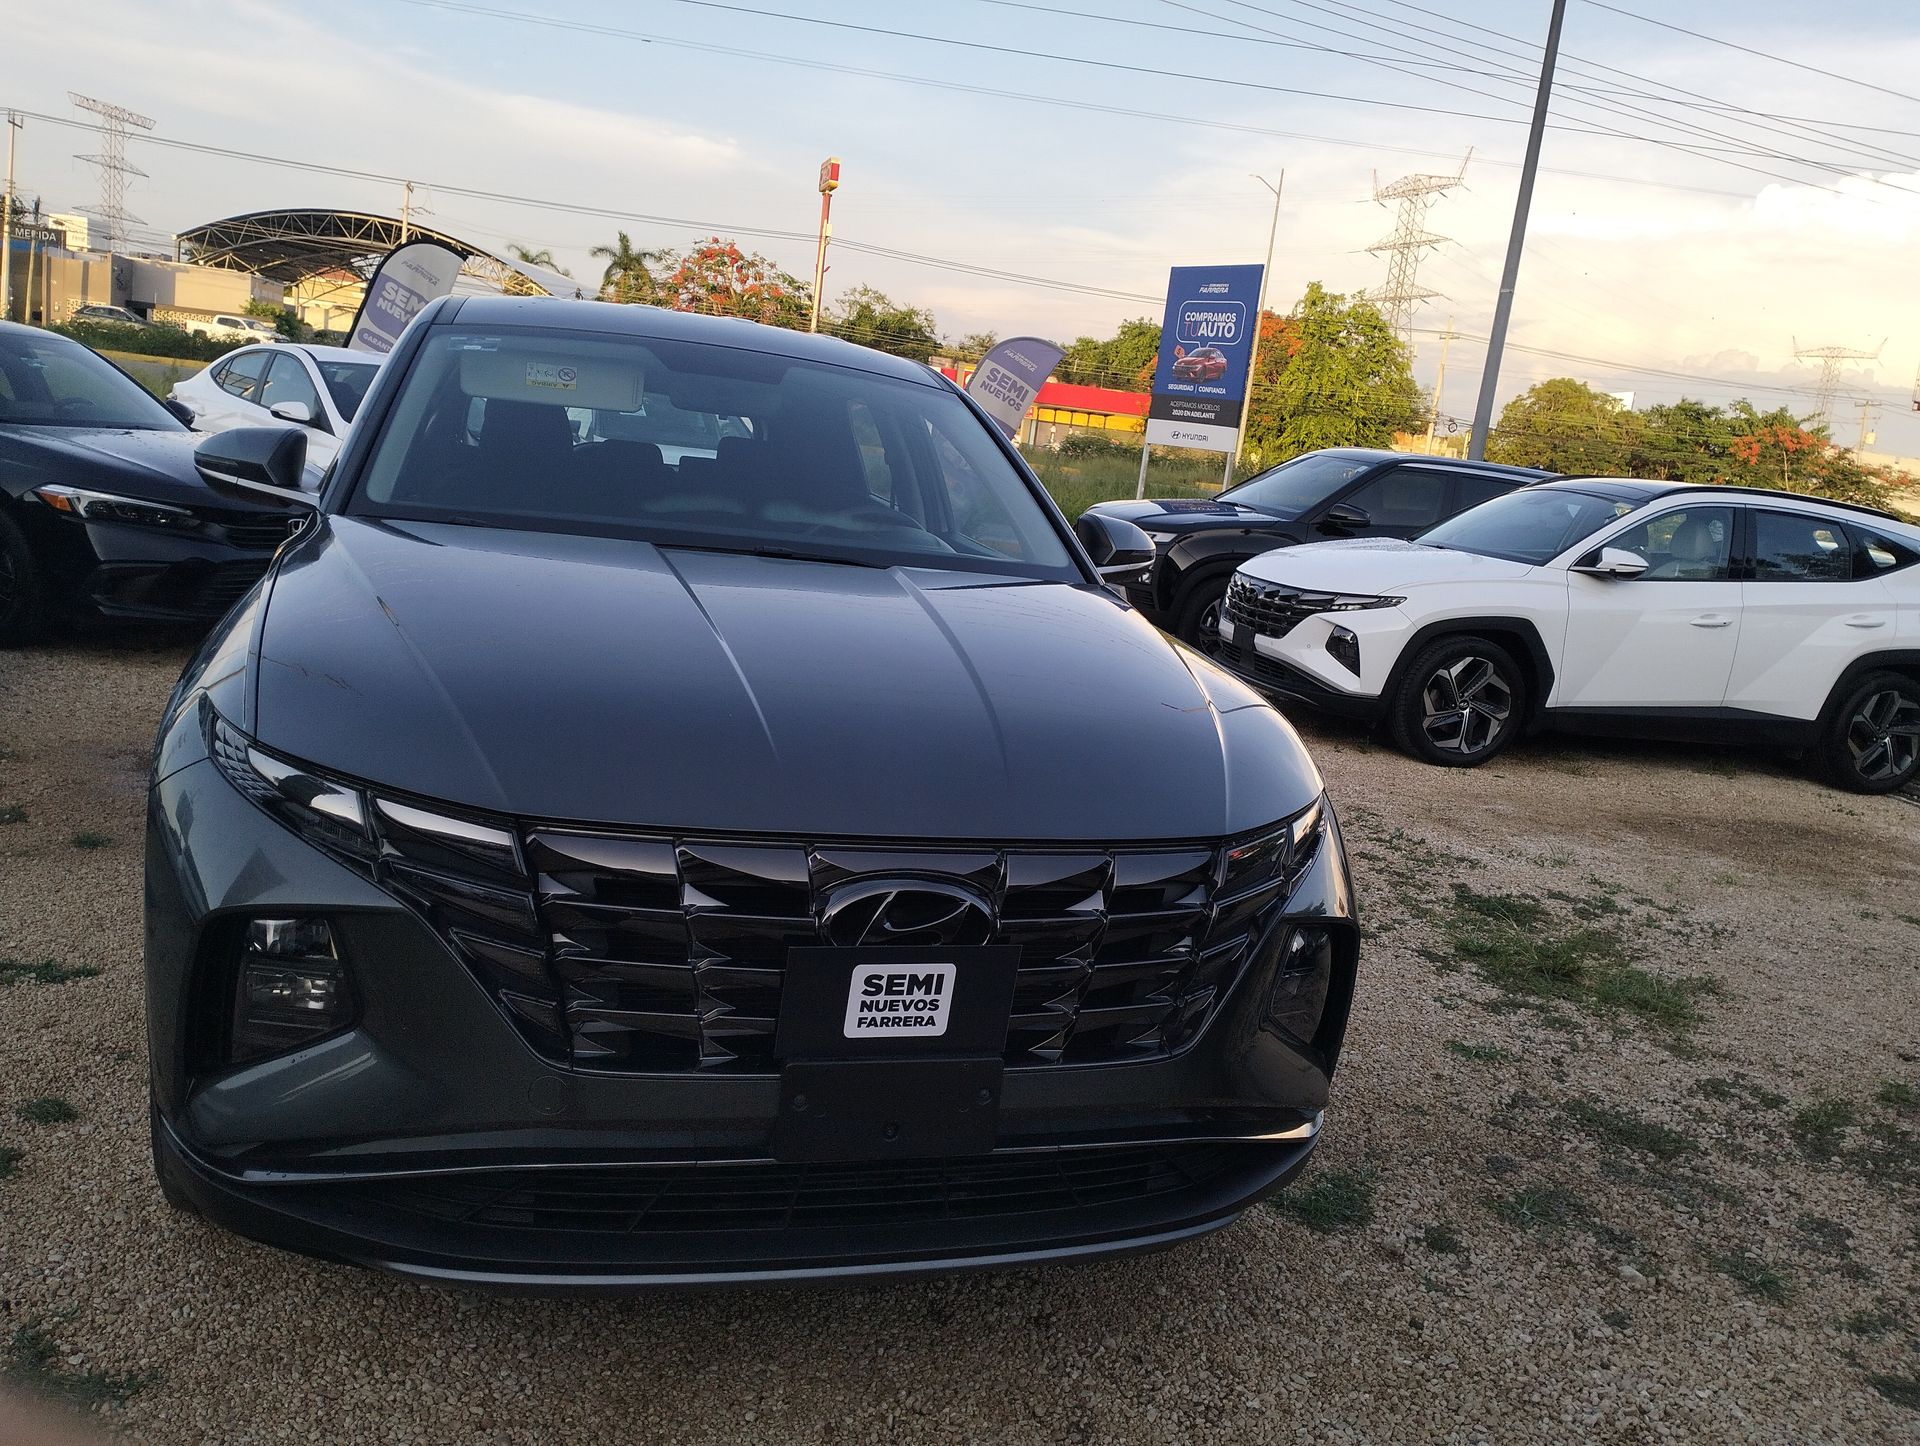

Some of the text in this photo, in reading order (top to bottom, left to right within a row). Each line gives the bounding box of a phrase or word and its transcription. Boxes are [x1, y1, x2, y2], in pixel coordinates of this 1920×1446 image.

[381, 281, 426, 312] SEM
[376, 297, 413, 323] NUEV
[1184, 312, 1237, 322] COMPRAMOS
[1184, 321, 1236, 338] TU AUTO
[986, 367, 1030, 403] SEMI
[1168, 383, 1227, 395] SEGURIDAD CONFIANZA
[979, 380, 1023, 412] NUEVOS
[1170, 400, 1221, 412] ACEPTAMOS MODELOS
[1172, 408, 1184, 416] 2020
[1190, 410, 1216, 420] ADELANTE
[1181, 433, 1209, 442] HYUNDAI
[861, 973, 945, 997] SEMI
[859, 999, 940, 1013] NUEVOS
[857, 1015, 937, 1028] FARRERA
